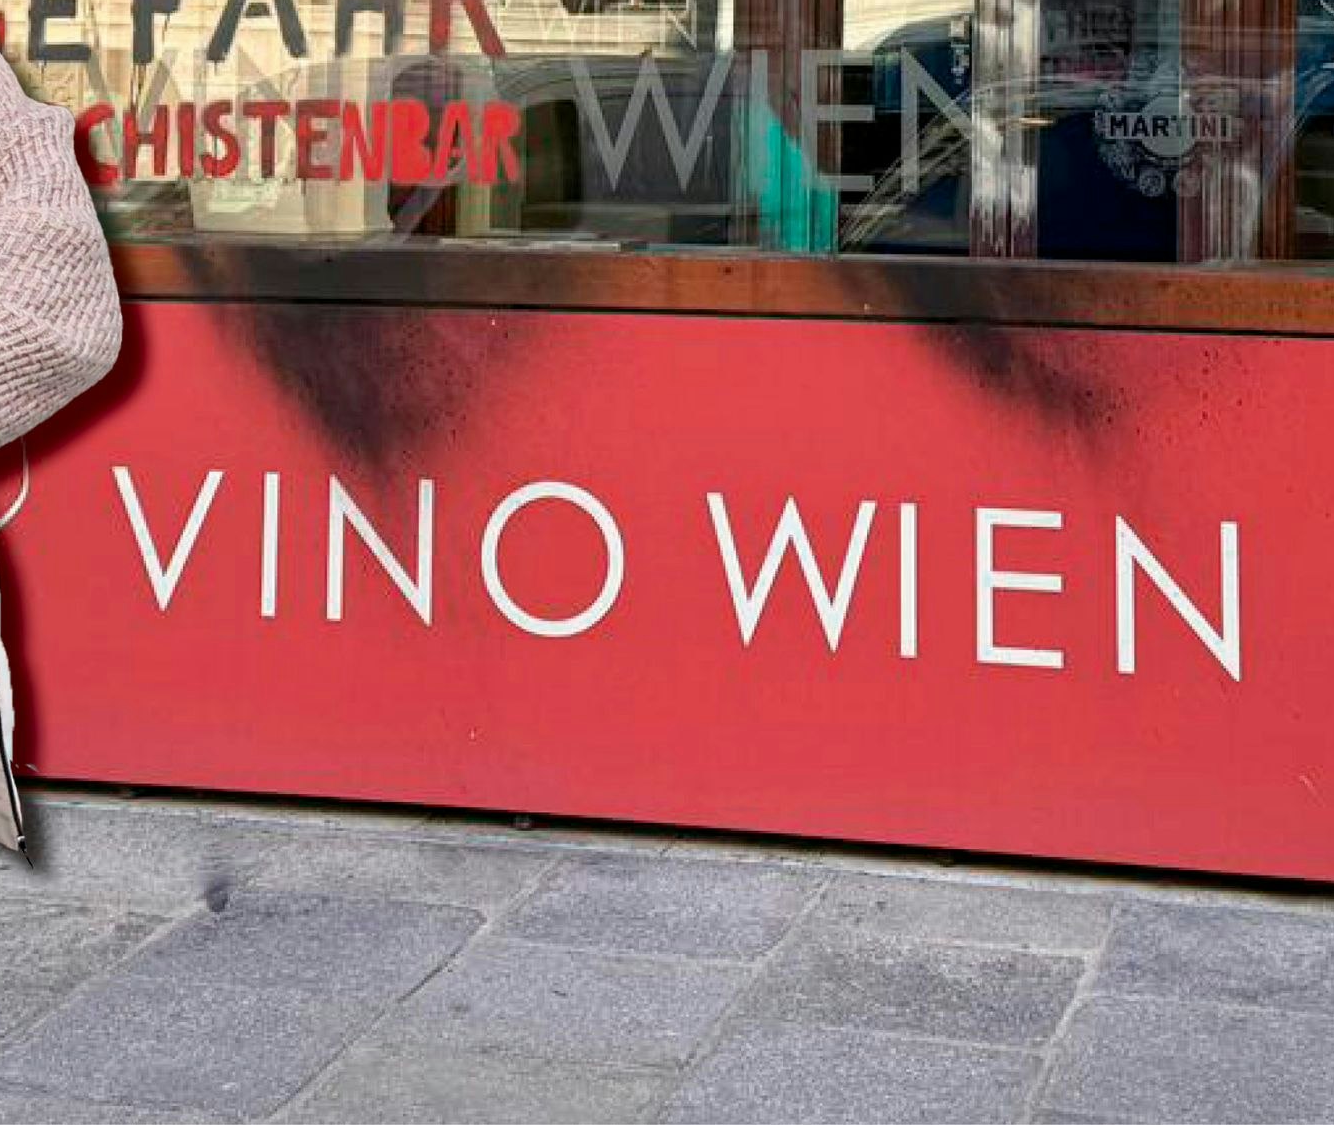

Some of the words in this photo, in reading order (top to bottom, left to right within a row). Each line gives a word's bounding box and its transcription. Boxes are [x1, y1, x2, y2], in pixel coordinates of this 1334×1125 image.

[569, 47, 1007, 194] WIEN
[1109, 114, 1231, 138] MARTINI
[112, 465, 625, 638] VINO
[707, 491, 1241, 681] WIEN
